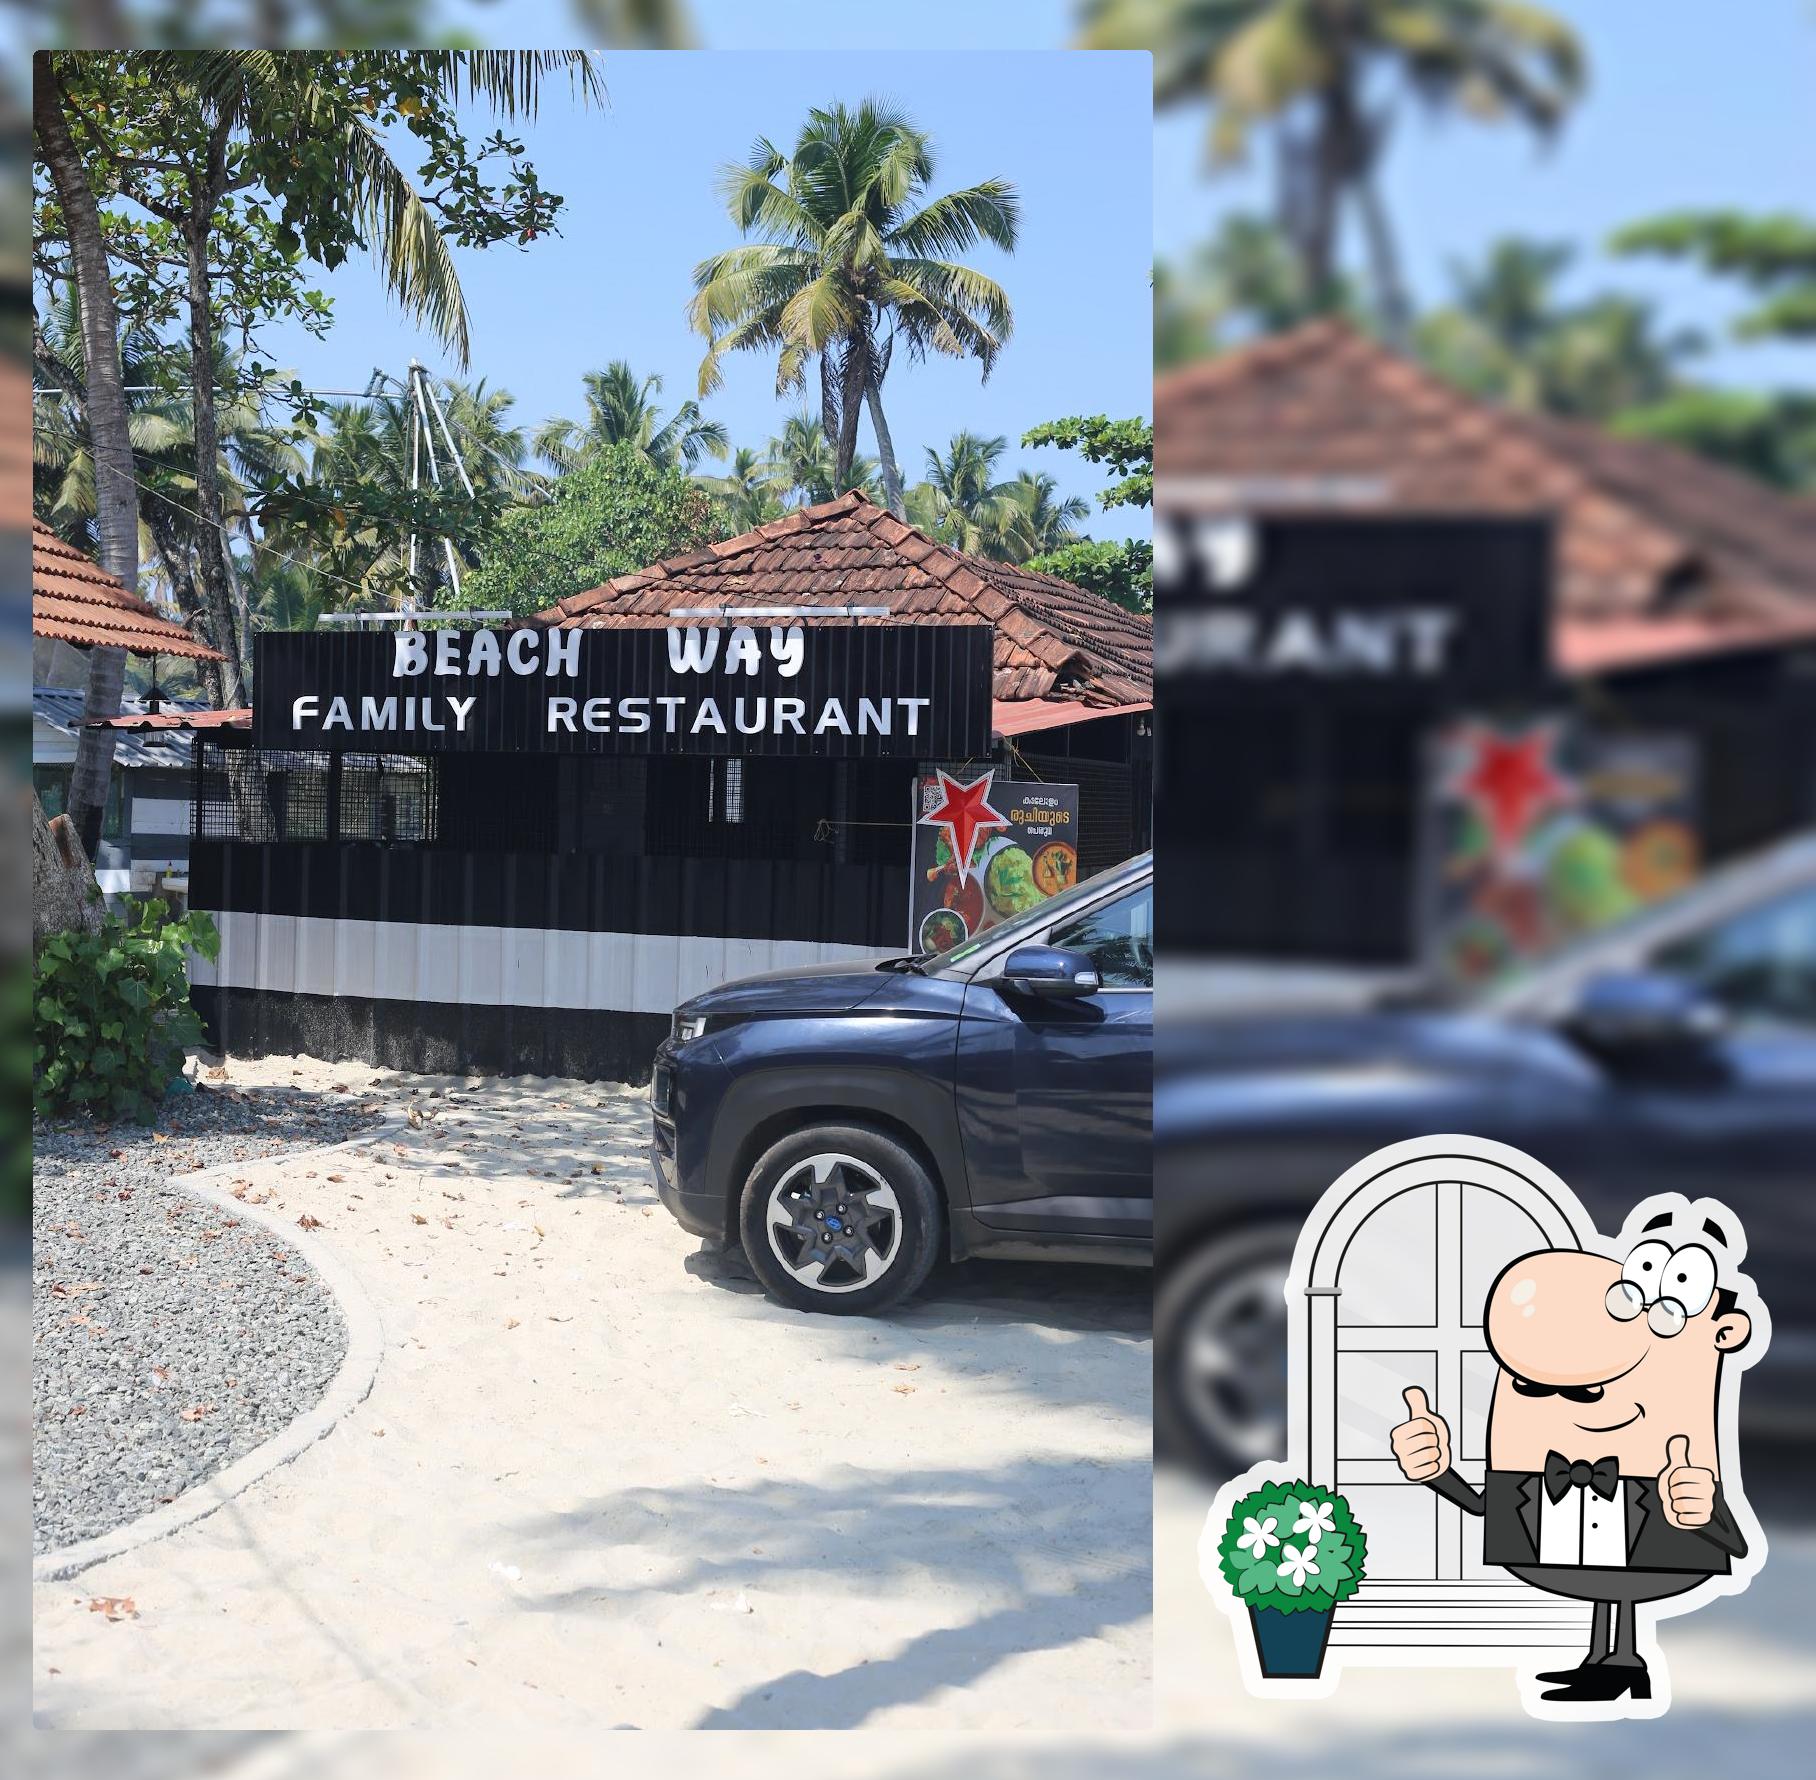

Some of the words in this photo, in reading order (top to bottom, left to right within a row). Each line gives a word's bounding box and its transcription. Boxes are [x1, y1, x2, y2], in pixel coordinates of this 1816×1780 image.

[392, 627, 583, 678] BEACH
[667, 626, 804, 677] WAY
[292, 695, 477, 731] FAMILY
[547, 696, 931, 736] RESTAURANT
[1010, 807, 1070, 826] രുചിയുടെ
